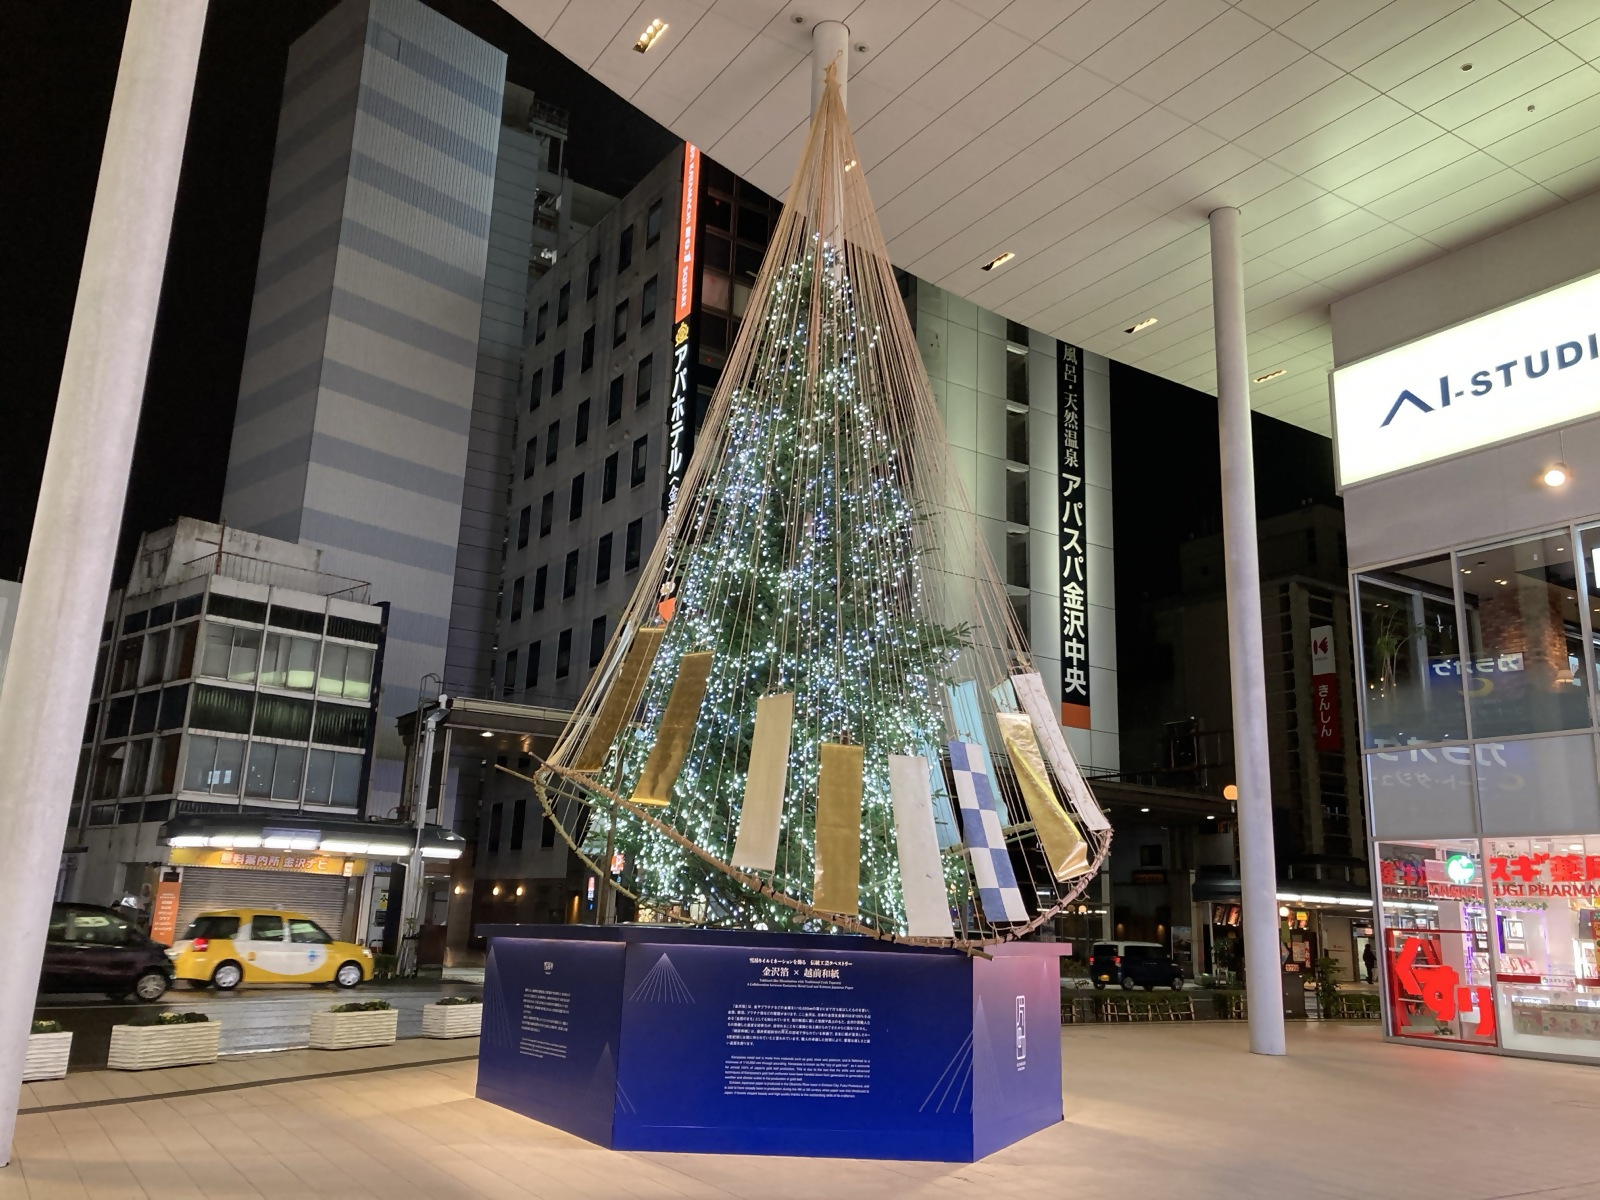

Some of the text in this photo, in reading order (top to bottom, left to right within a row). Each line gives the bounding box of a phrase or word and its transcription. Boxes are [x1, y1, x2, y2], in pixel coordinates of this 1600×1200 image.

[1062, 472, 1087, 697] アパスパ金沢中央
[1318, 684, 1332, 738] きんしん
[283, 856, 328, 870] 金沢ナビ
[1528, 884, 1600, 897] PHARMA
[762, 966, 789, 977] 金沢箔
[1396, 936, 1495, 1036] くすり
